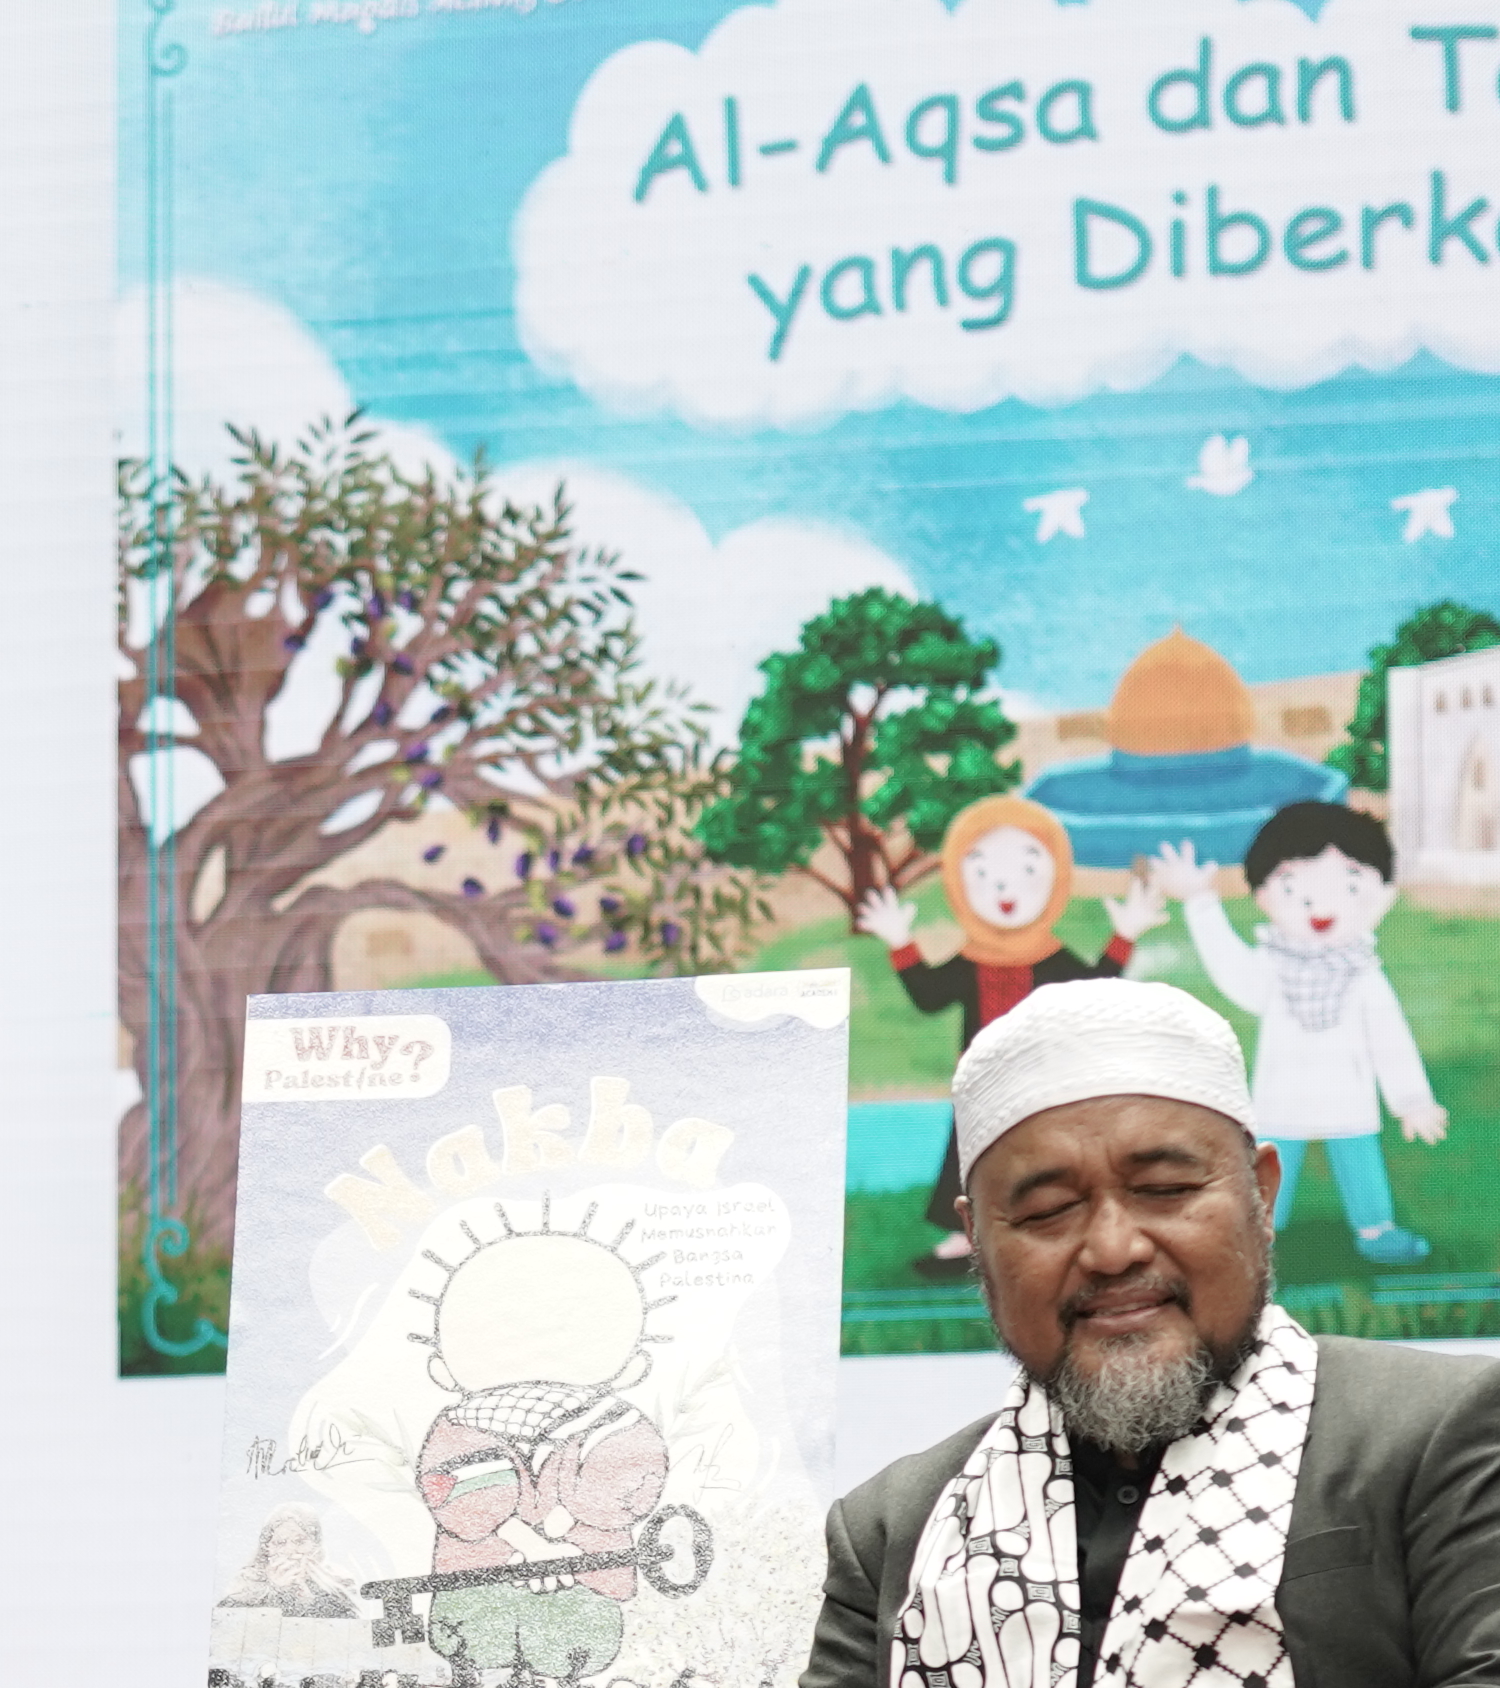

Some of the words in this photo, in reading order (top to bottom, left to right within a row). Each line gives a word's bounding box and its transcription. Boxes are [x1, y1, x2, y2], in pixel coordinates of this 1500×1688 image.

[634, 82, 1100, 203] Al-Aqsa
[1147, 35, 1357, 134] dan
[747, 238, 1018, 362] yang
[323, 1076, 736, 1252] Nakba
[644, 1202, 708, 1221] Upaya
[716, 1196, 776, 1217] Israel
[660, 1270, 754, 1288] Palestina
[673, 1248, 744, 1265] Bangsa
